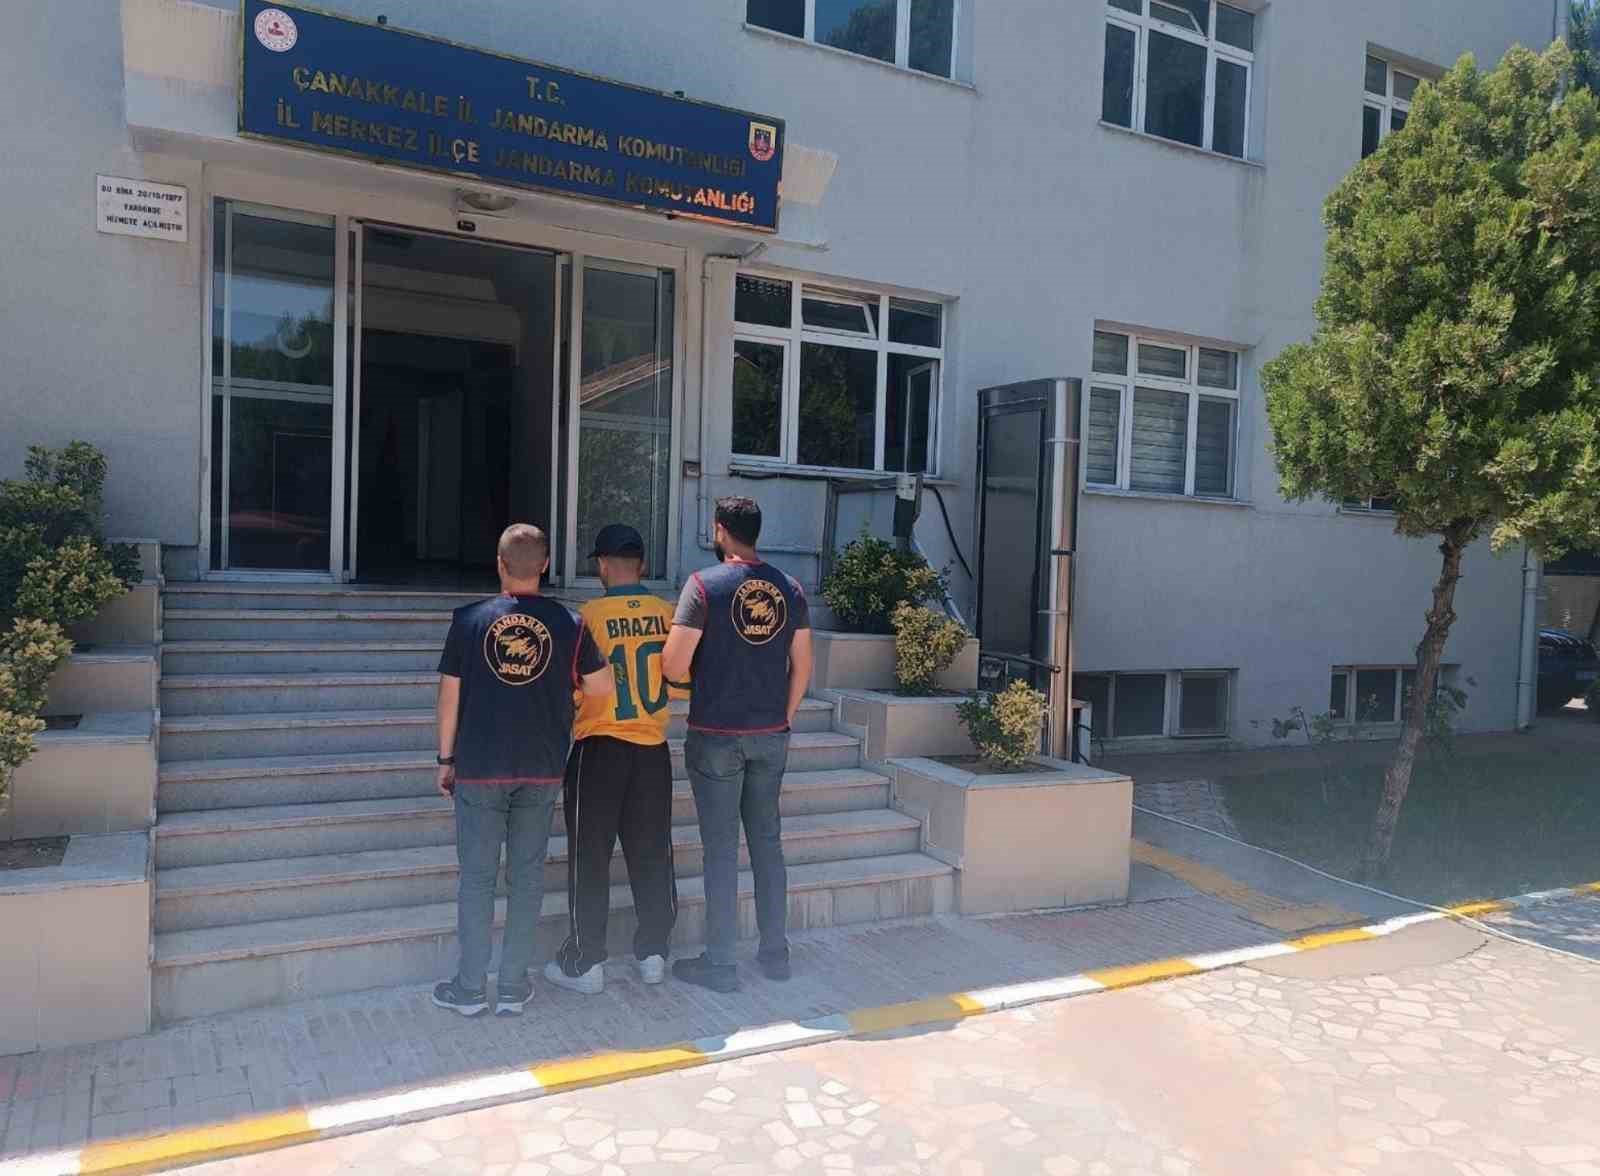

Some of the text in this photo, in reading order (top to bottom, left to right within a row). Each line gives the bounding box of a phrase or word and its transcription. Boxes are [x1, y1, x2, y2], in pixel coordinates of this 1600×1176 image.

[525, 75, 567, 106] T.C.
[292, 66, 449, 118] ÇANAKKALE
[458, 95, 479, 124] İL
[488, 109, 609, 152] JANDARMA
[276, 97, 755, 215] İL MERKEZ İLÇE JANDARMA KOMUTANLIĞI
[737, 580, 783, 605] JANDARMA
[491, 615, 548, 642] JANDARMA
[606, 615, 670, 639] BRAZIL
[744, 625, 771, 635] JASAT
[498, 662, 535, 676] JASAT
[608, 641, 669, 721] 10
